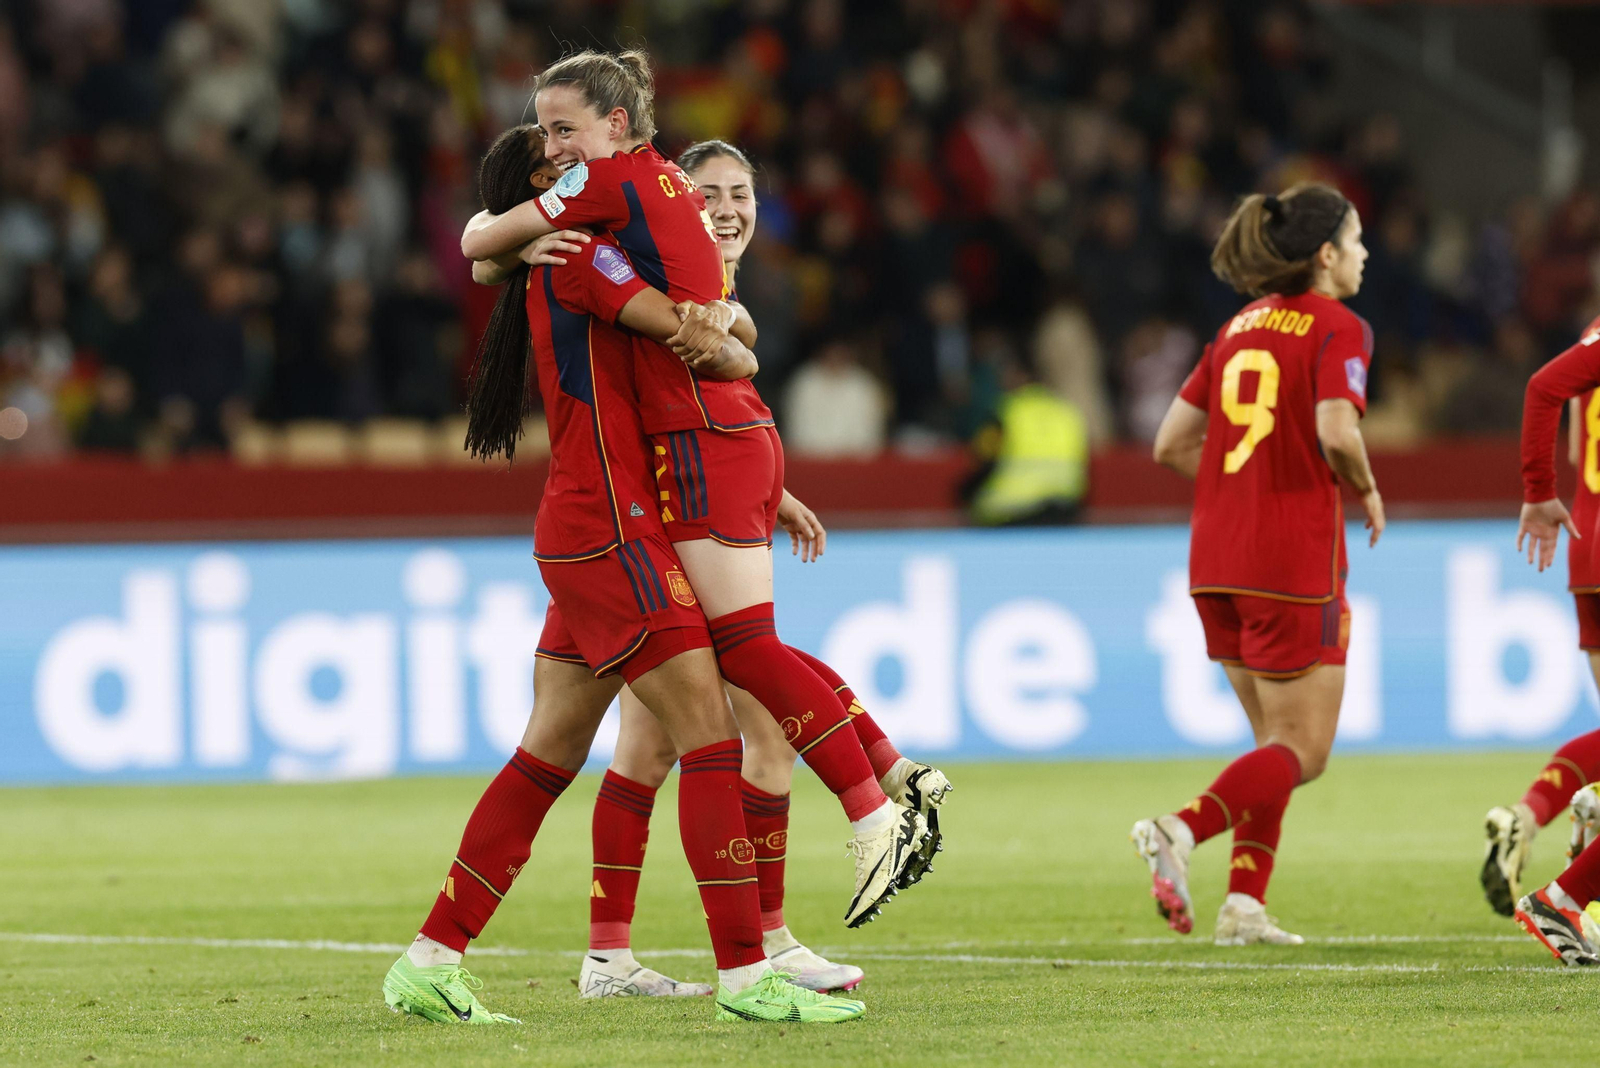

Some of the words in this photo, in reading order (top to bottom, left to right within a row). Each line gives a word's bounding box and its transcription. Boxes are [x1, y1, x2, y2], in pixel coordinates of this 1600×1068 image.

[1225, 306, 1316, 338] REDONDO
[1220, 347, 1281, 475] 9
[35, 549, 620, 782] digit
[823, 554, 1098, 752] de
[1446, 544, 1600, 742] b
[714, 849, 727, 860] 19
